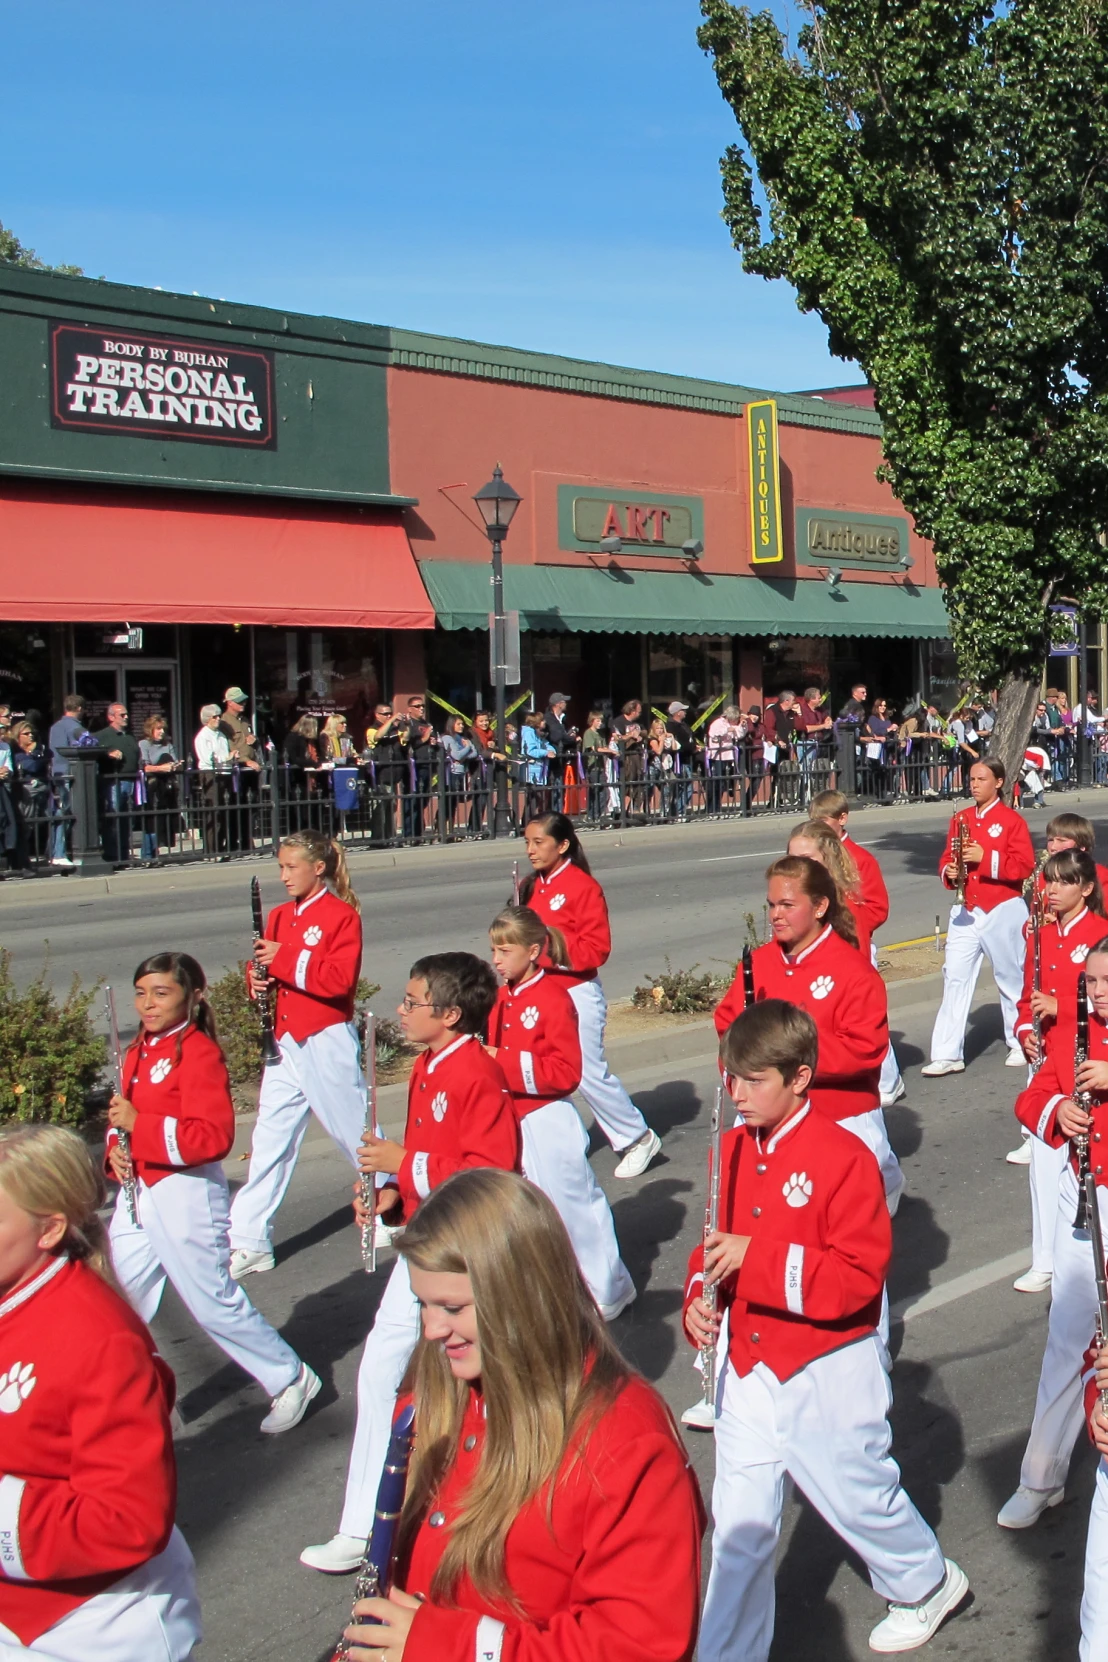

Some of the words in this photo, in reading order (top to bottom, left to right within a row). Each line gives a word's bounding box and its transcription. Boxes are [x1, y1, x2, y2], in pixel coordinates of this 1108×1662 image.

[103, 340, 145, 358] BODY
[149, 346, 169, 361] BY
[174, 351, 229, 369] BIJHAN
[75, 355, 255, 402] PERSONAL
[67, 383, 263, 432] TRAINING
[757, 418, 770, 546] ANTIQUES
[601, 504, 671, 543] ART
[812, 522, 899, 558] Antiques
[1038, 1114, 1047, 1132] PJHS
[167, 1134, 176, 1153] PJHS
[416, 1157, 424, 1176] PJHS
[789, 1265, 798, 1288] PJHS
[0, 1530, 15, 1562] PJHS
